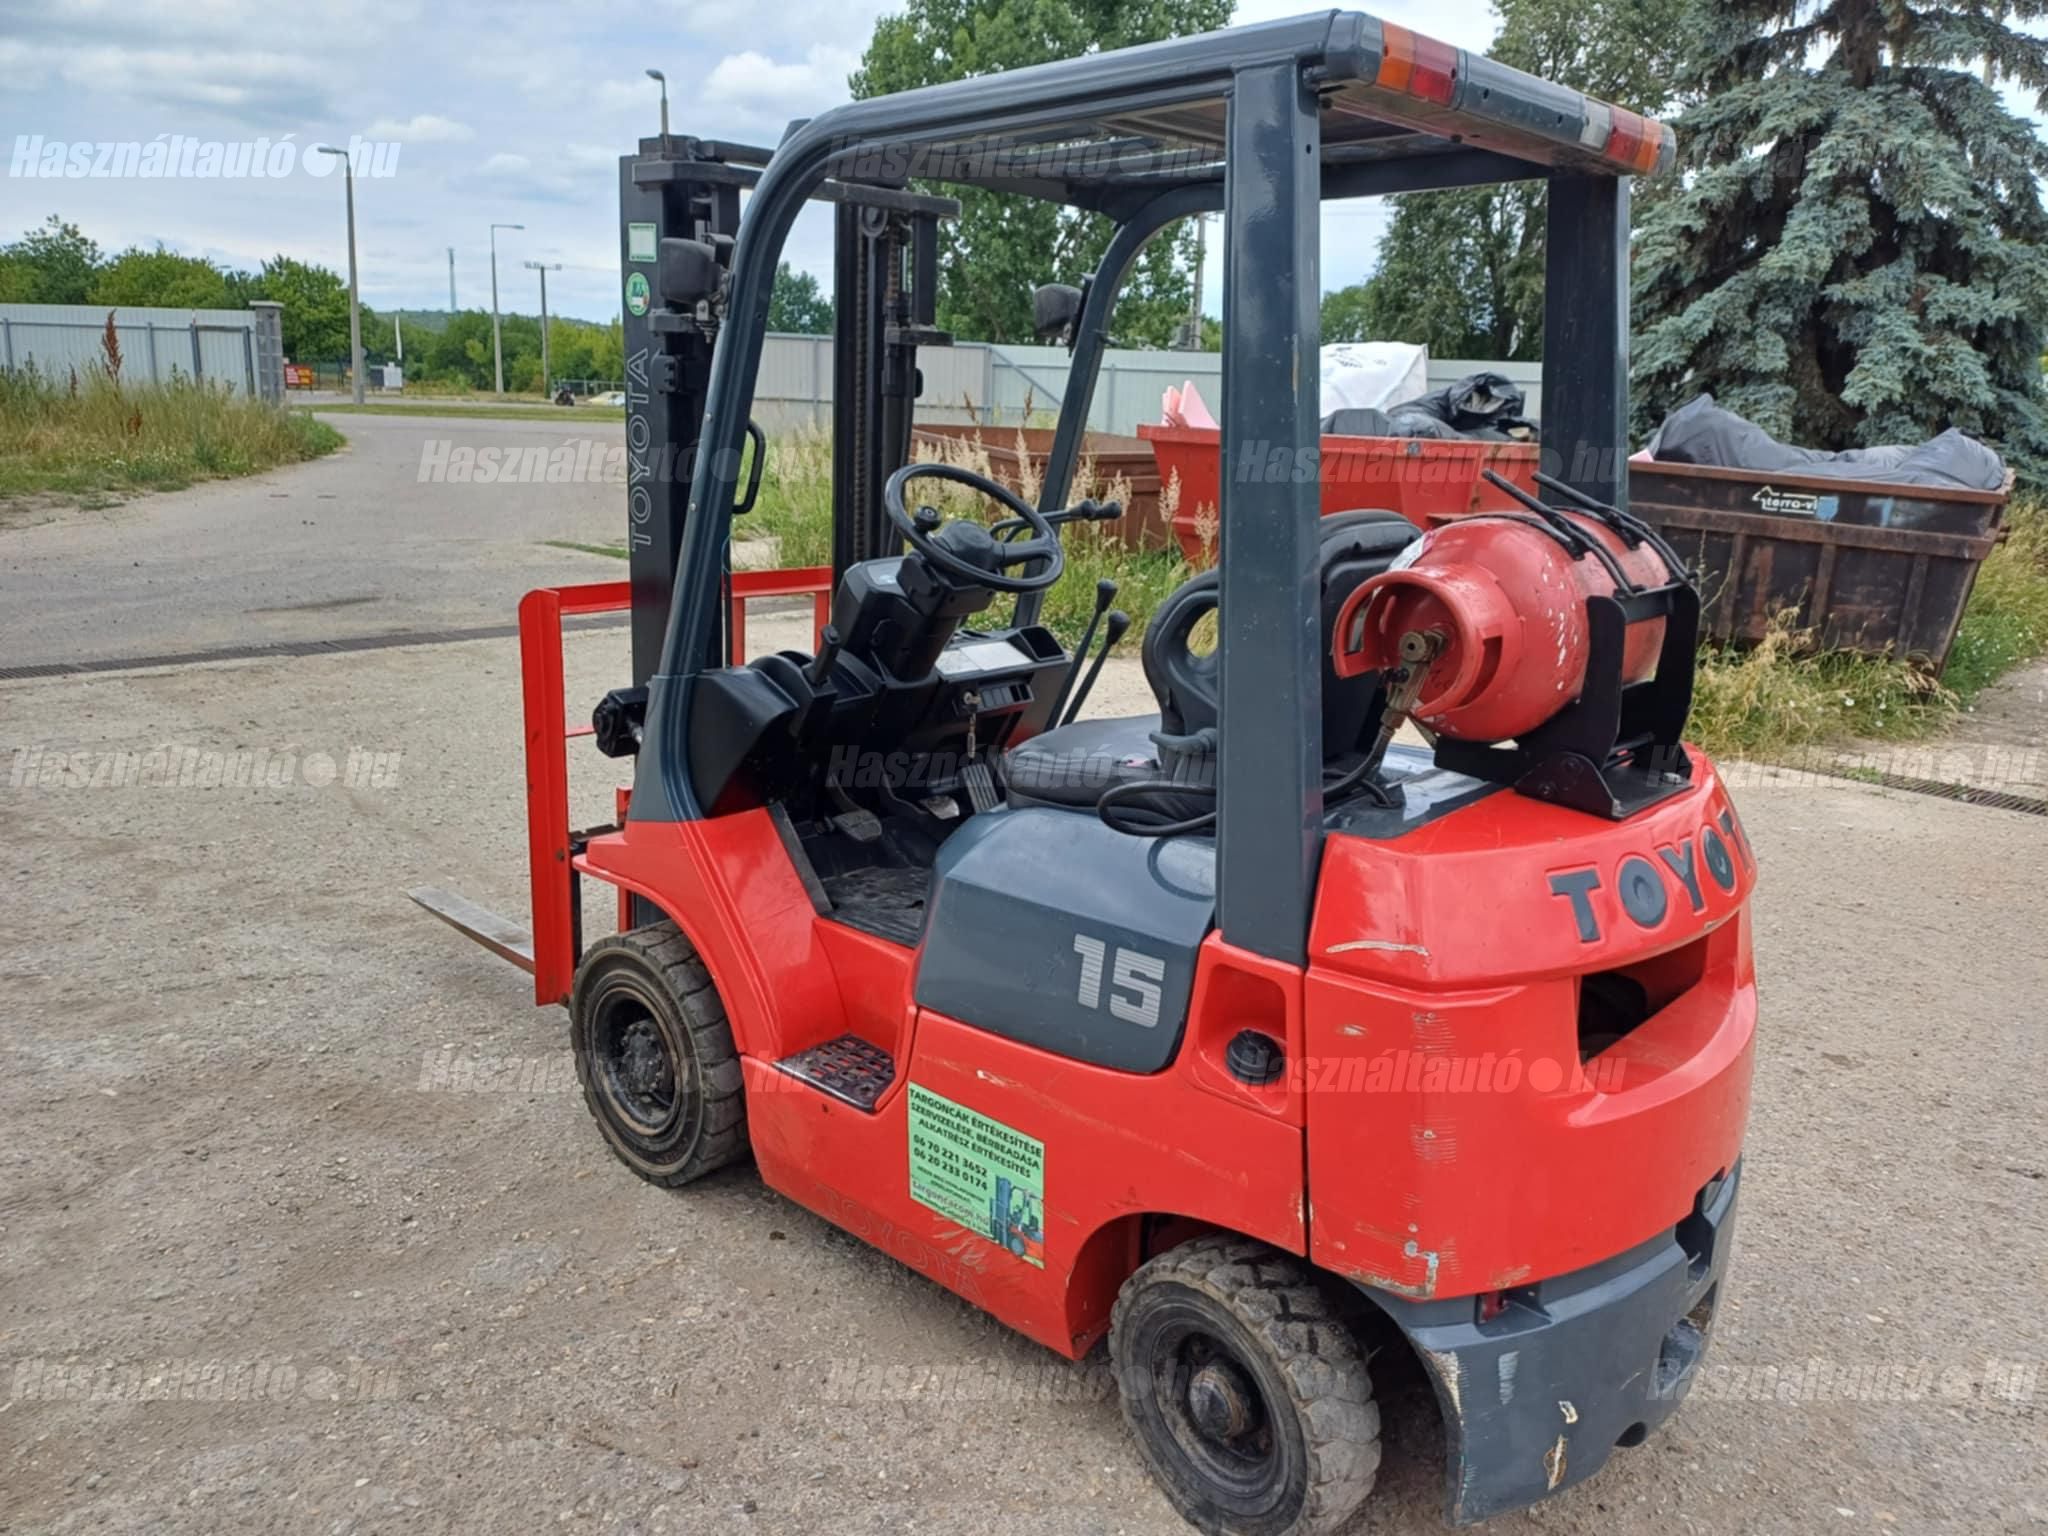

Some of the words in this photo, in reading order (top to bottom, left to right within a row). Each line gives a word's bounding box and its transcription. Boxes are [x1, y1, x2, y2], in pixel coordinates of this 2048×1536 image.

[627, 348, 652, 552] TOYOTA
[1547, 808, 1750, 943] TOYOT
[1073, 933, 1166, 1028] 15
[909, 1088, 969, 1122] TARGONCÁK
[913, 1134, 926, 1148] 06
[927, 1140, 940, 1154] 70
[942, 1146, 959, 1163] 221
[962, 1157, 988, 1177] 3652
[913, 1147, 926, 1161] 06
[927, 1153, 940, 1167] 20
[942, 1160, 960, 1177] 233
[962, 1170, 988, 1191] 0174
[918, 1119, 969, 1150] ALKATRÉSZ
[971, 1142, 1031, 1178] ÉRTÉKESÍTÉS
